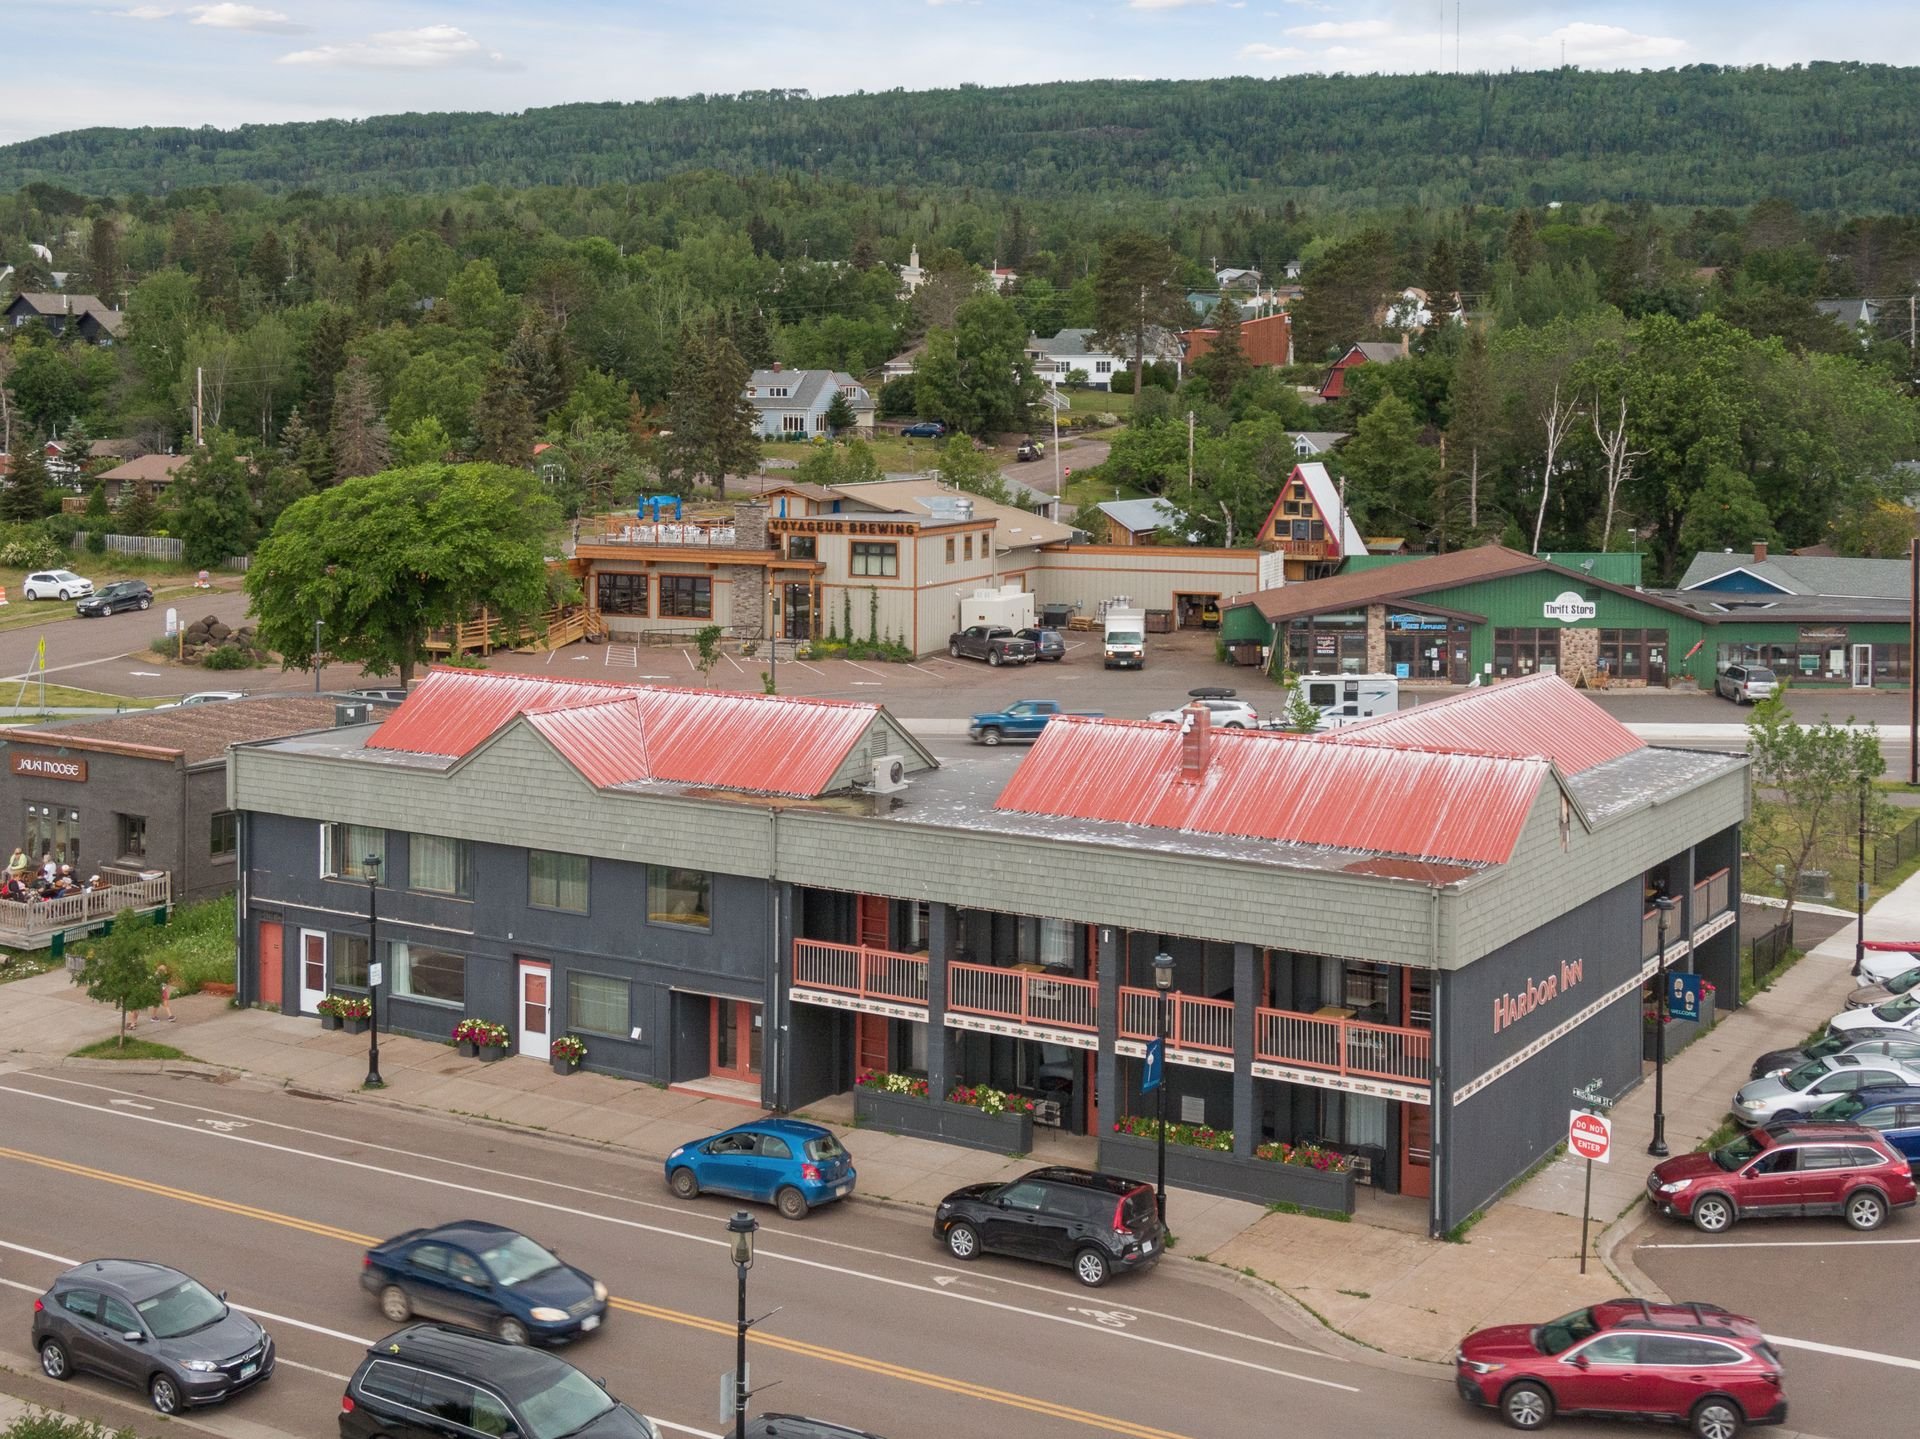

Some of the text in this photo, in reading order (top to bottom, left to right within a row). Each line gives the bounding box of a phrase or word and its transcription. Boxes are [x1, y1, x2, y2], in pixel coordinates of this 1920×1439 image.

[772, 519, 914, 535] VOYAGEUR BREWING
[1546, 604, 1594, 615] Thrift Store
[17, 758, 79, 776] JAVA MOOSE
[1670, 1008, 1697, 1018] WELCOME
[1576, 1120, 1604, 1134] DO NOT
[1577, 1139, 1601, 1153] ENTER
